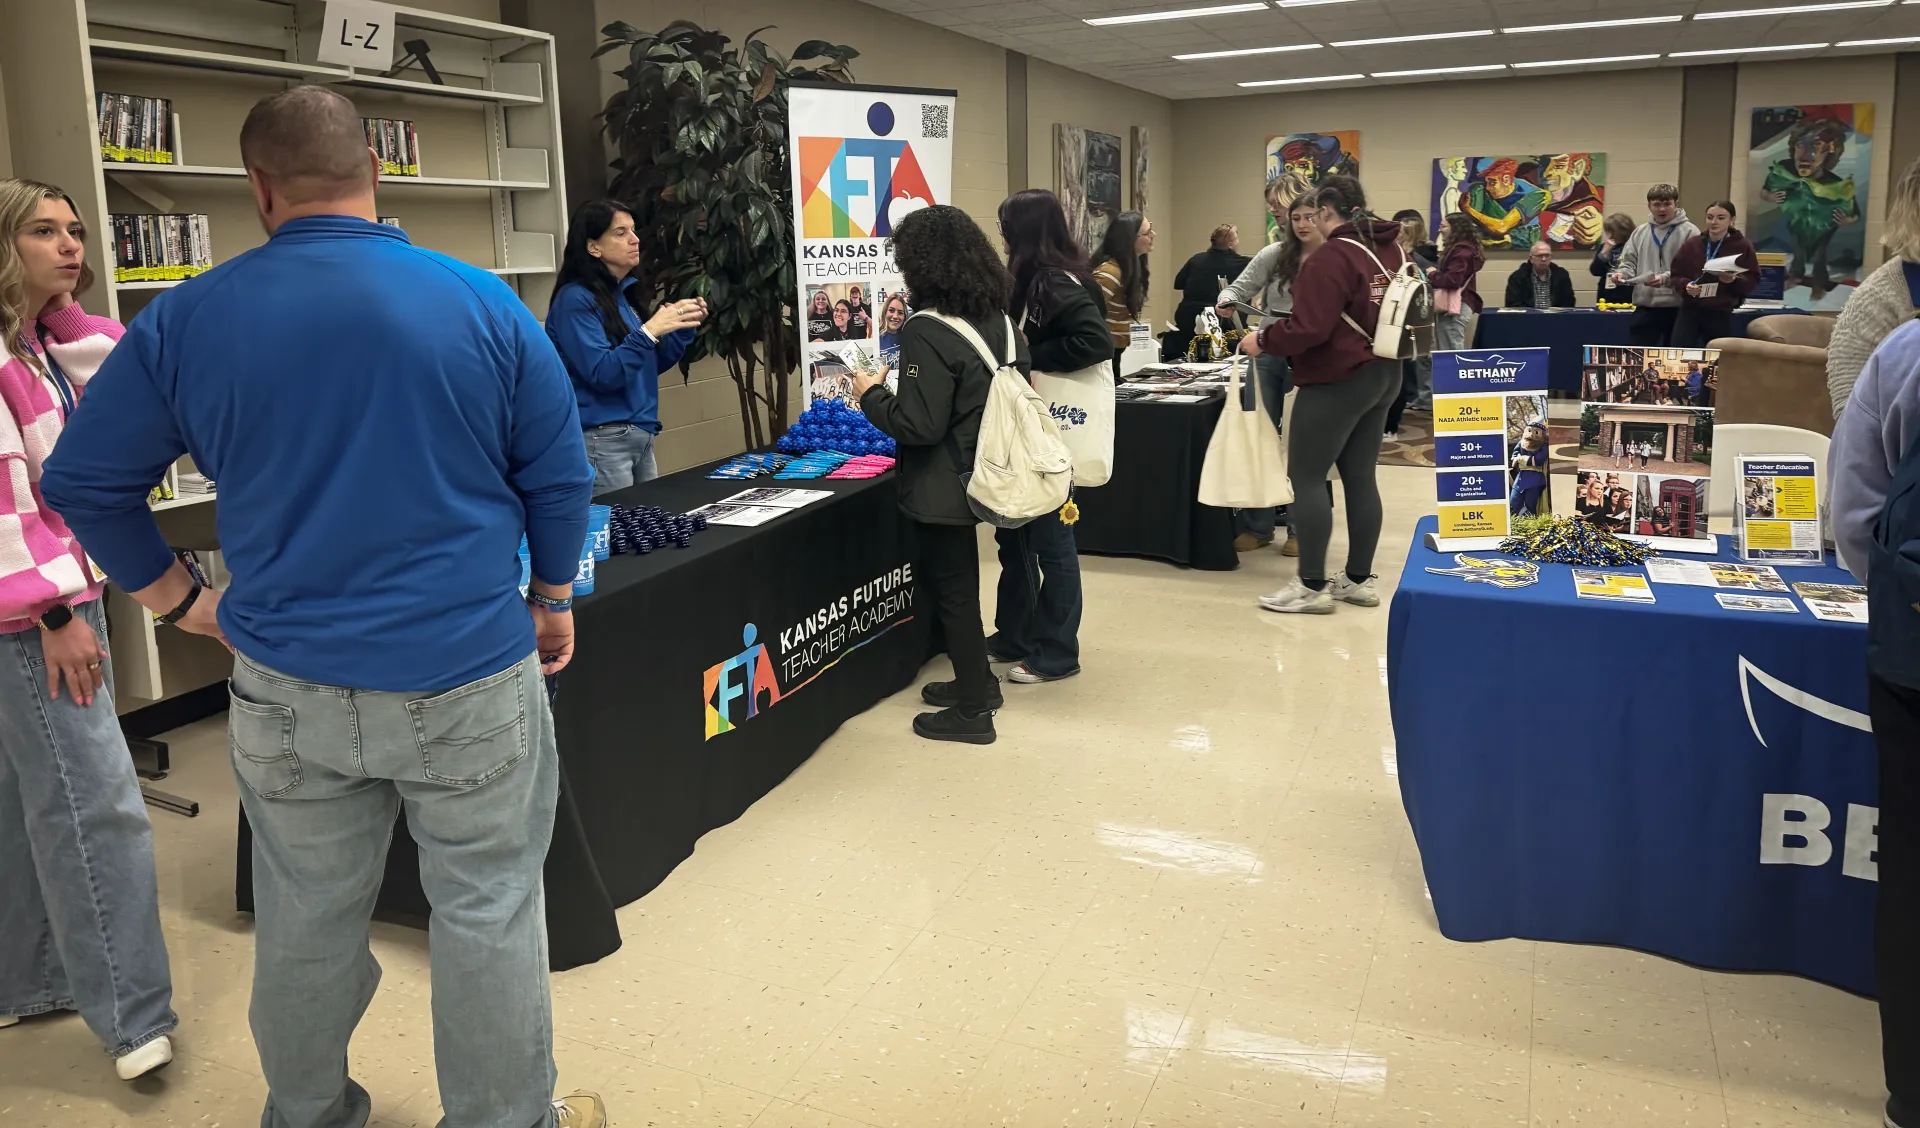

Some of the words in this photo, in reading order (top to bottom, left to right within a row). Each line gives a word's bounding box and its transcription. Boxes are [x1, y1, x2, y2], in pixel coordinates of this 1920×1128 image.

[340, 18, 380, 50] L-Z
[803, 244, 878, 259] KANSAS
[802, 262, 877, 277] TEACHER
[1458, 368, 1518, 378] BETHANY
[1459, 406, 1480, 416] 20+
[1460, 442, 1482, 452] 30+
[1462, 476, 1484, 486] 20+
[1462, 511, 1484, 520] LBK
[780, 596, 848, 654] KANSAS
[853, 563, 913, 610] FUTURE
[782, 624, 846, 682] TEACHER
[848, 587, 914, 638] ACADEMY
[1760, 793, 1879, 882] BE
